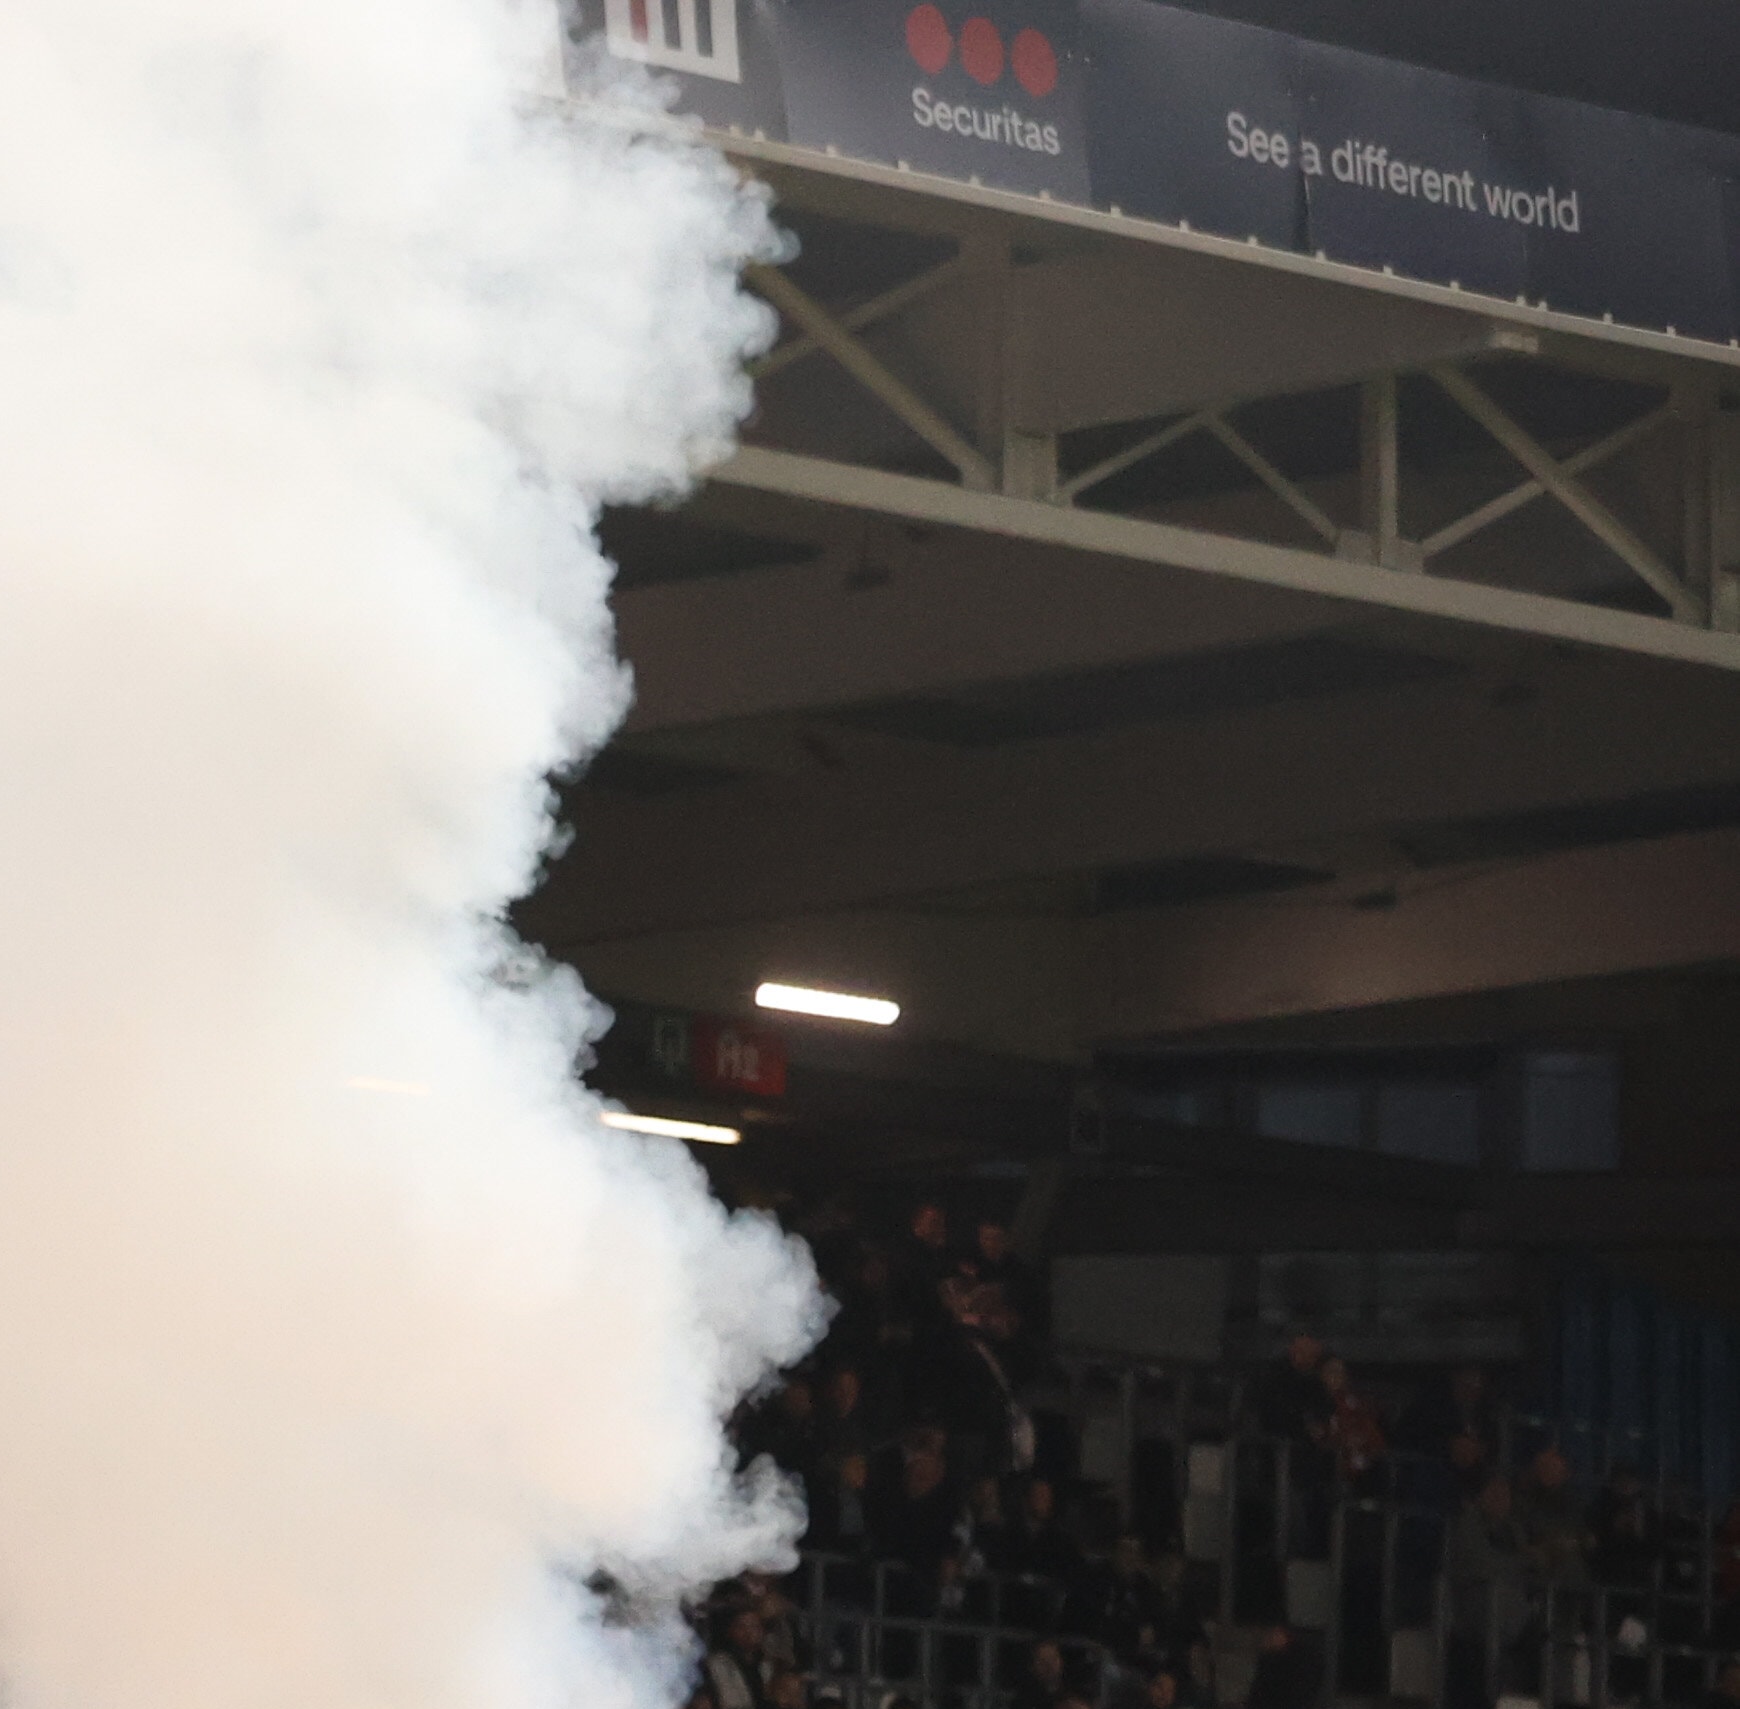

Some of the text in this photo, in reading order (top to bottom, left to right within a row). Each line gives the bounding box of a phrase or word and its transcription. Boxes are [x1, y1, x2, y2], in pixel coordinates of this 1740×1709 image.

[911, 86, 1061, 155] Securitas
[1226, 111, 1581, 233] See a different world
